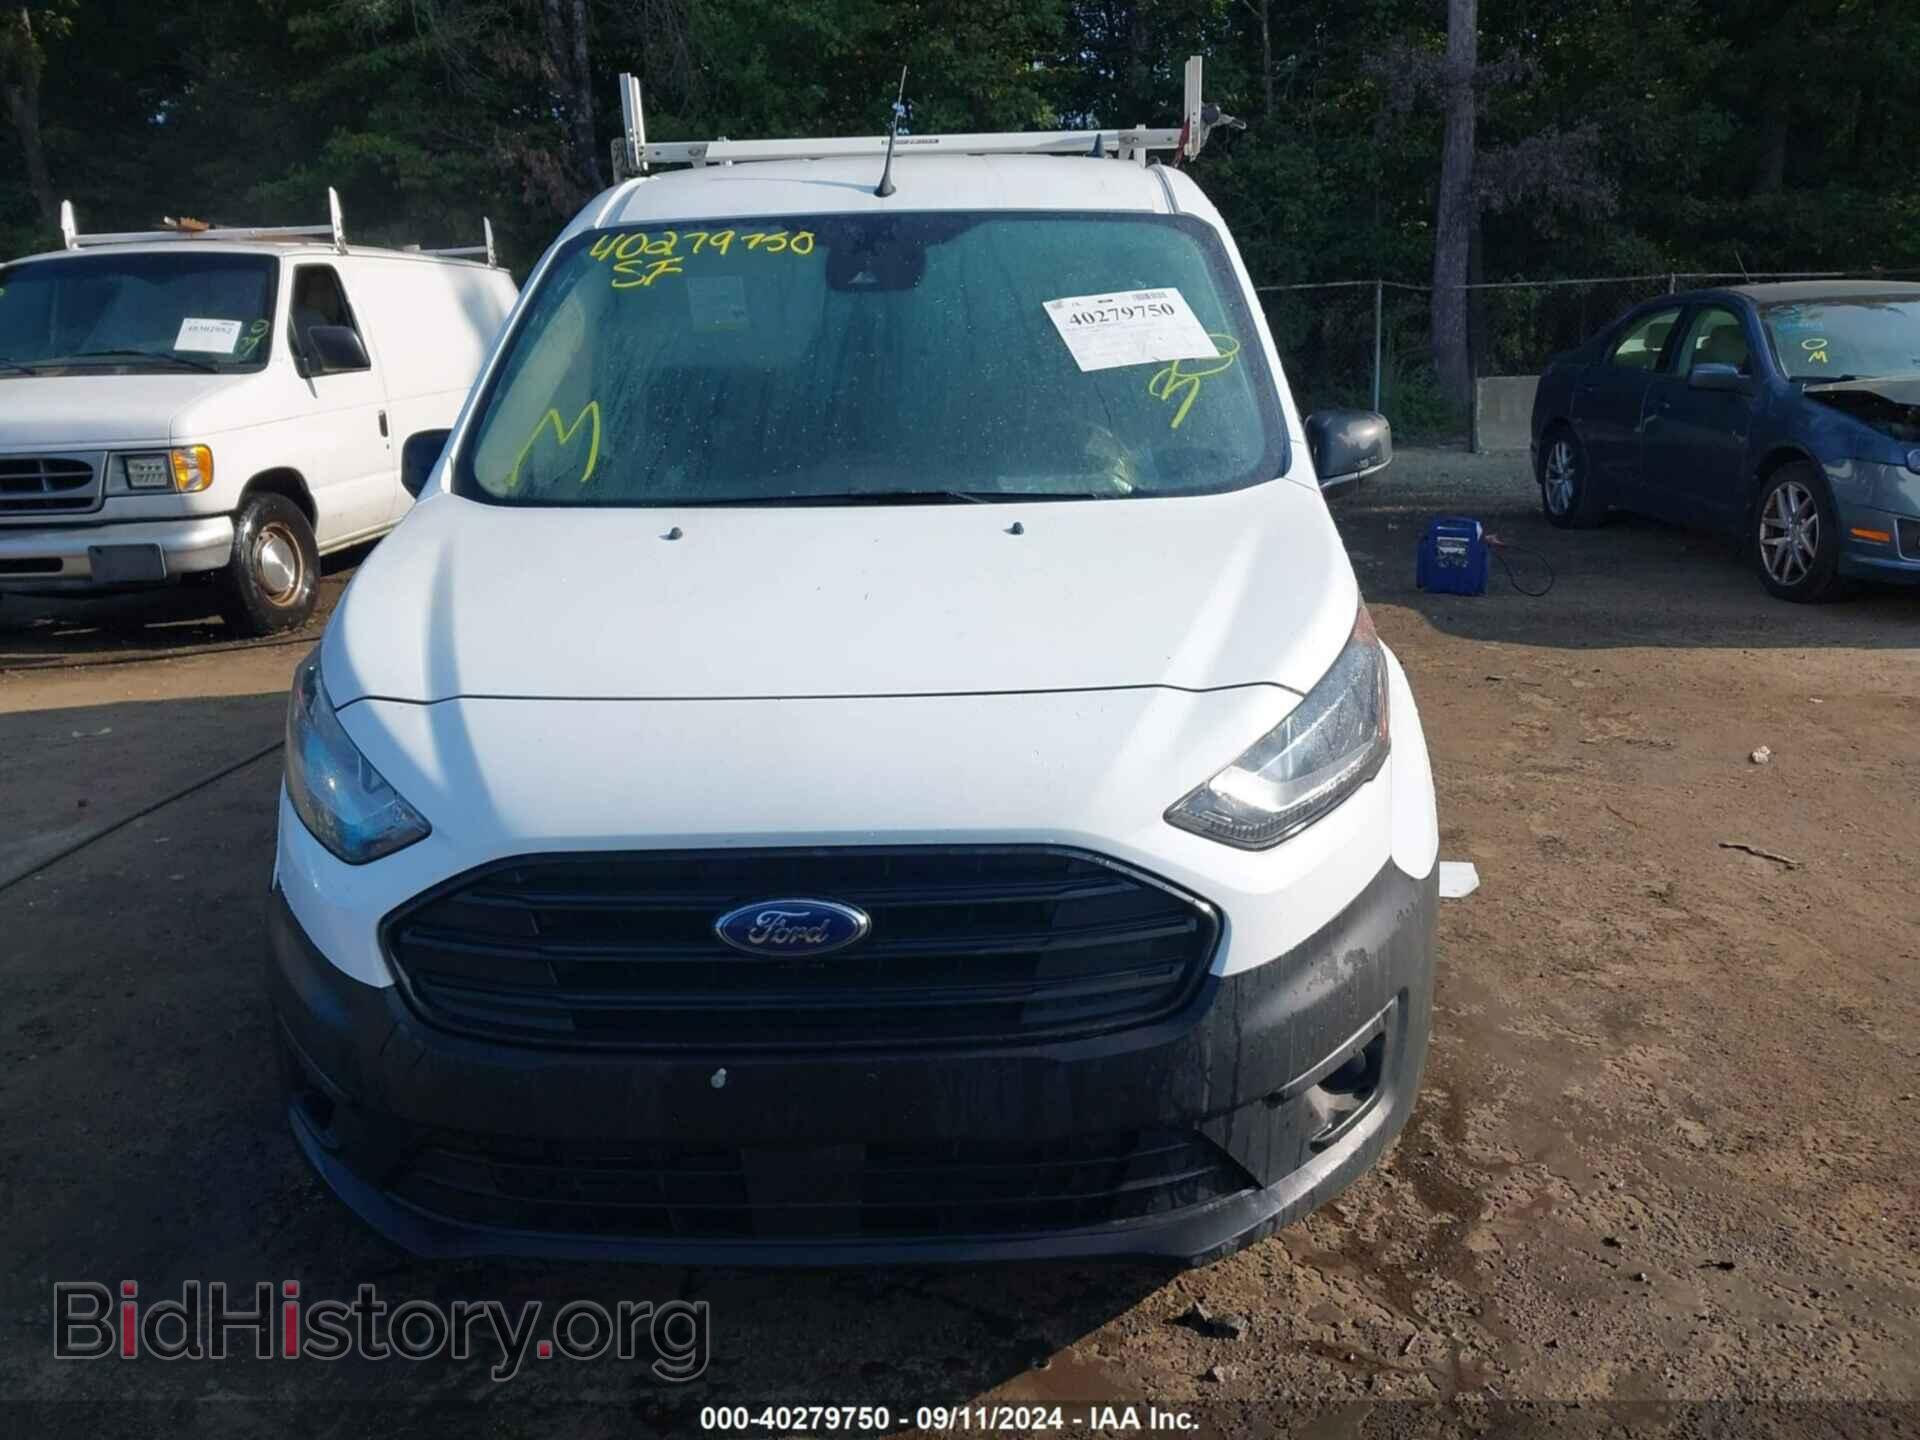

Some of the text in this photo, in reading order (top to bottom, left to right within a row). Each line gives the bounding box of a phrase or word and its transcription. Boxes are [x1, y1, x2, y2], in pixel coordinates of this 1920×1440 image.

[1069, 302, 1176, 326] 40279750
[504, 400, 600, 488] M
[748, 910, 831, 944] Ford
